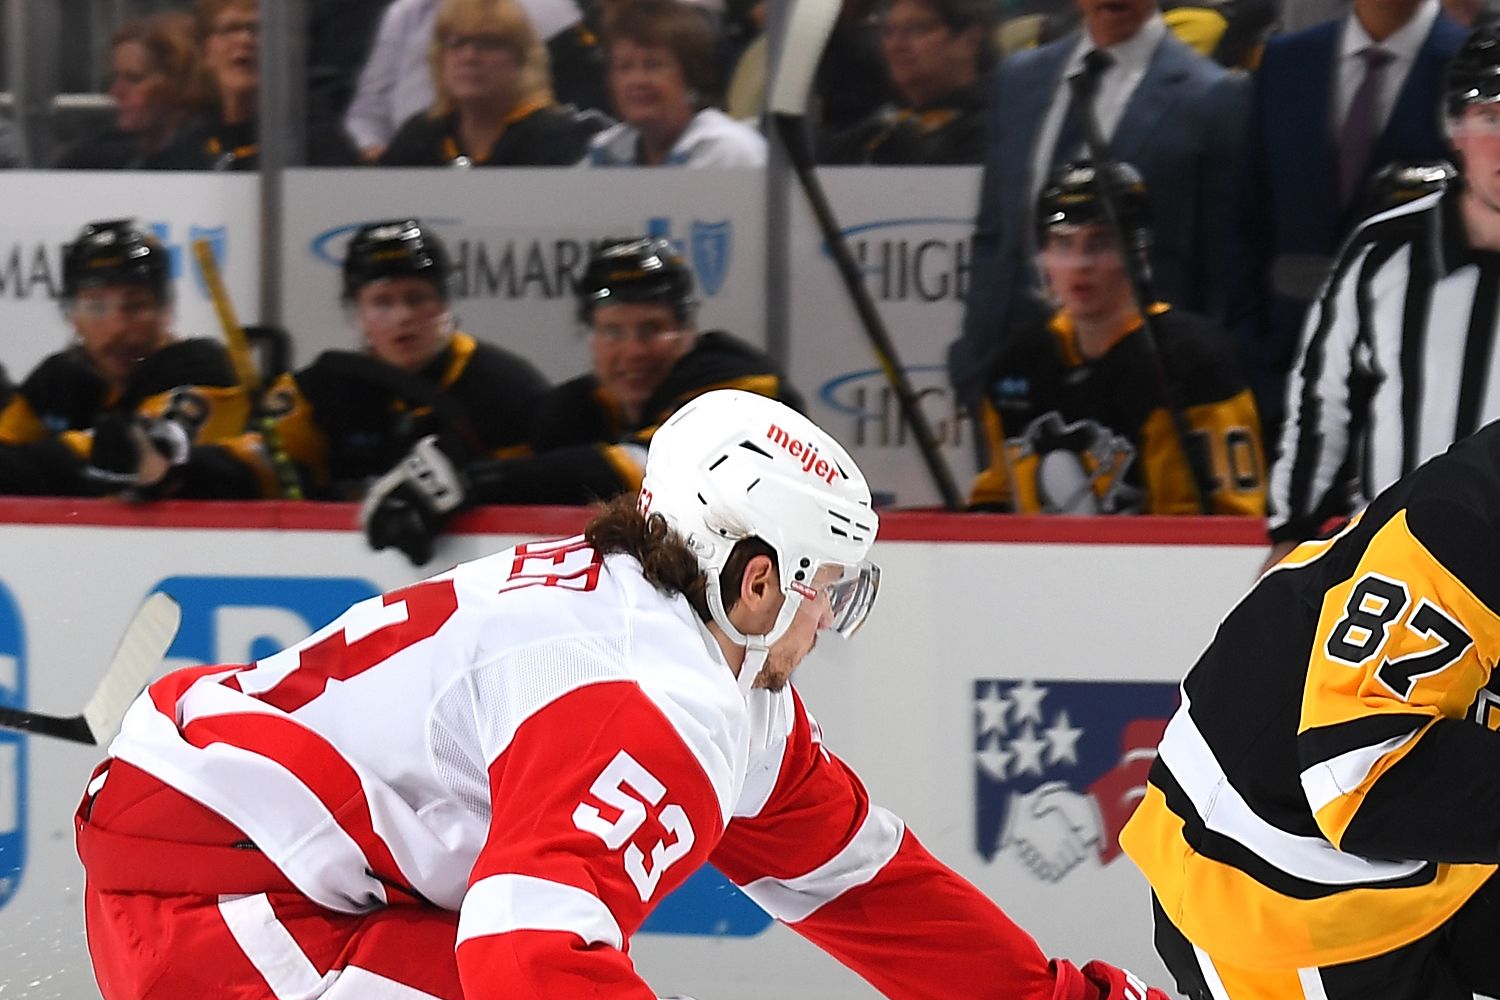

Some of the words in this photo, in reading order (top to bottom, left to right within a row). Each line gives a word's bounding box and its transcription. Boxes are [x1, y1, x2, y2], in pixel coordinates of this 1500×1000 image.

[766, 423, 840, 487] meijer
[1324, 570, 1476, 703] 87
[571, 748, 696, 904] 53
